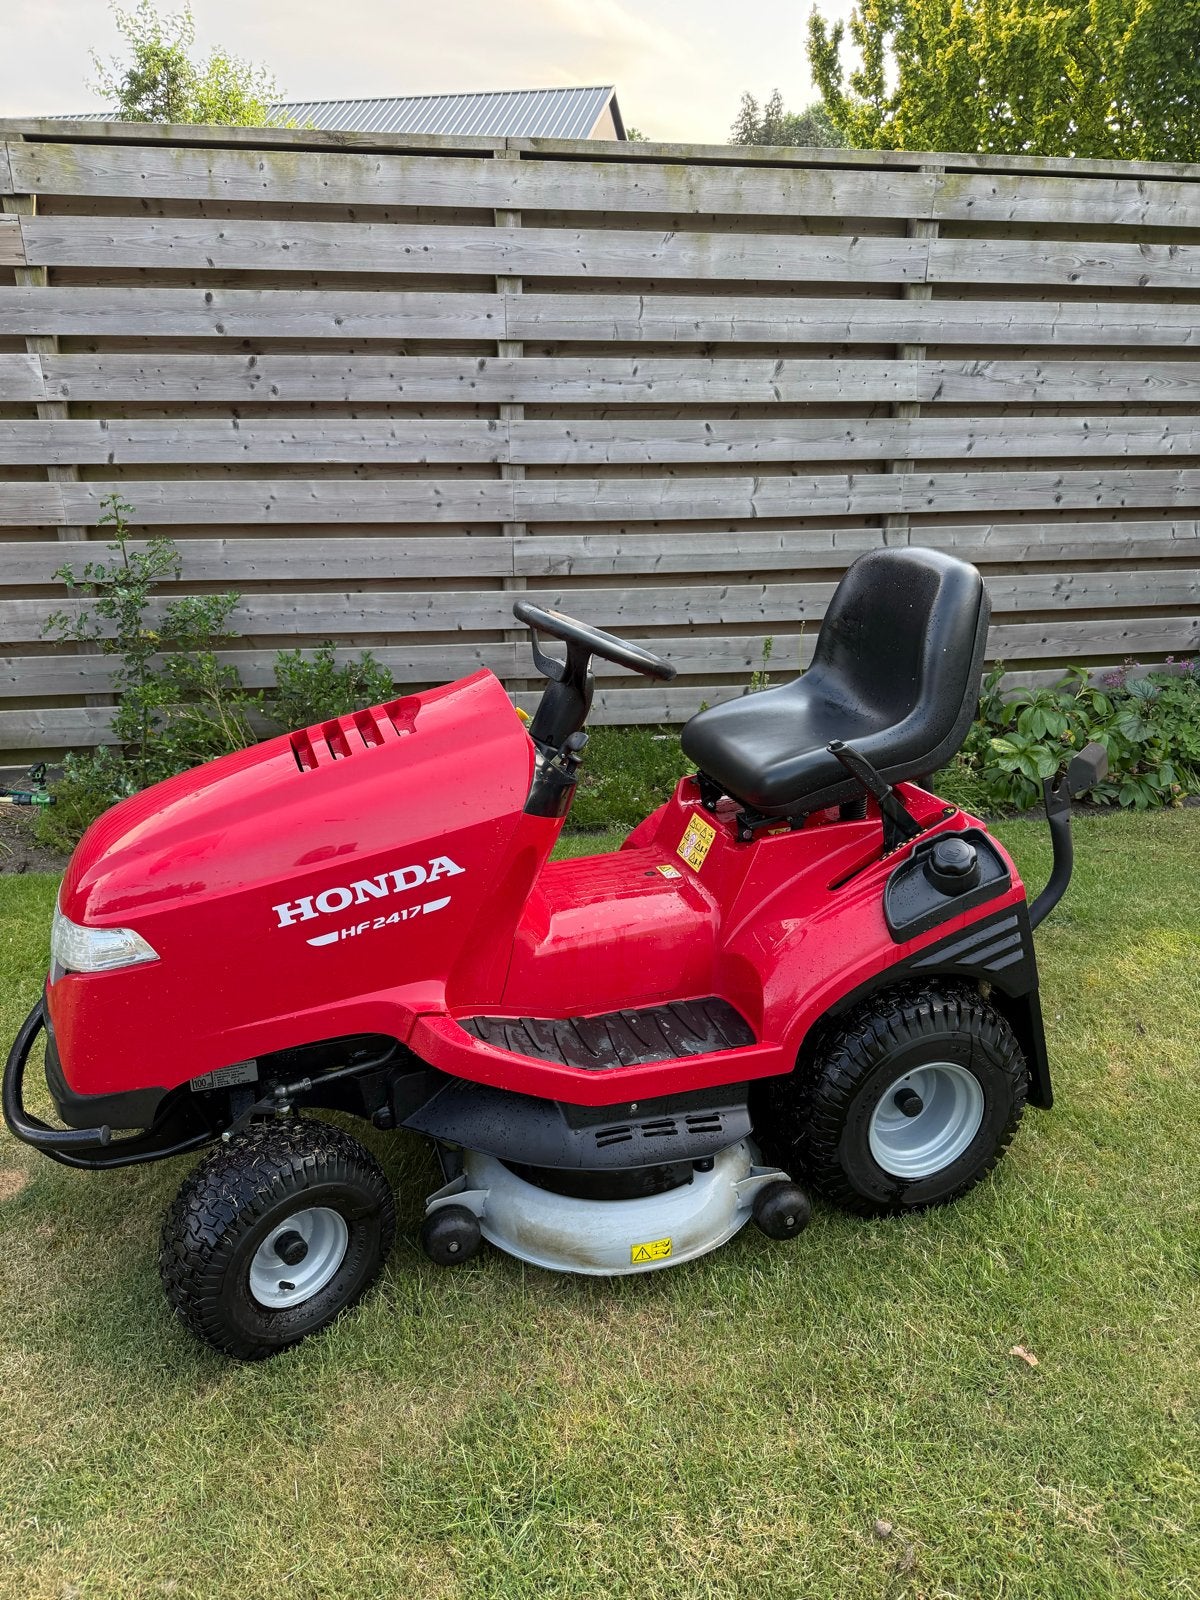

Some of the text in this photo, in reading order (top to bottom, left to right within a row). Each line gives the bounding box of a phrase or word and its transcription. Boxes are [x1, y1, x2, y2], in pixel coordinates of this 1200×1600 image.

[272, 856, 465, 927] HONDA
[341, 905, 421, 939] HF 2417
[194, 1079, 206, 1087] 100
